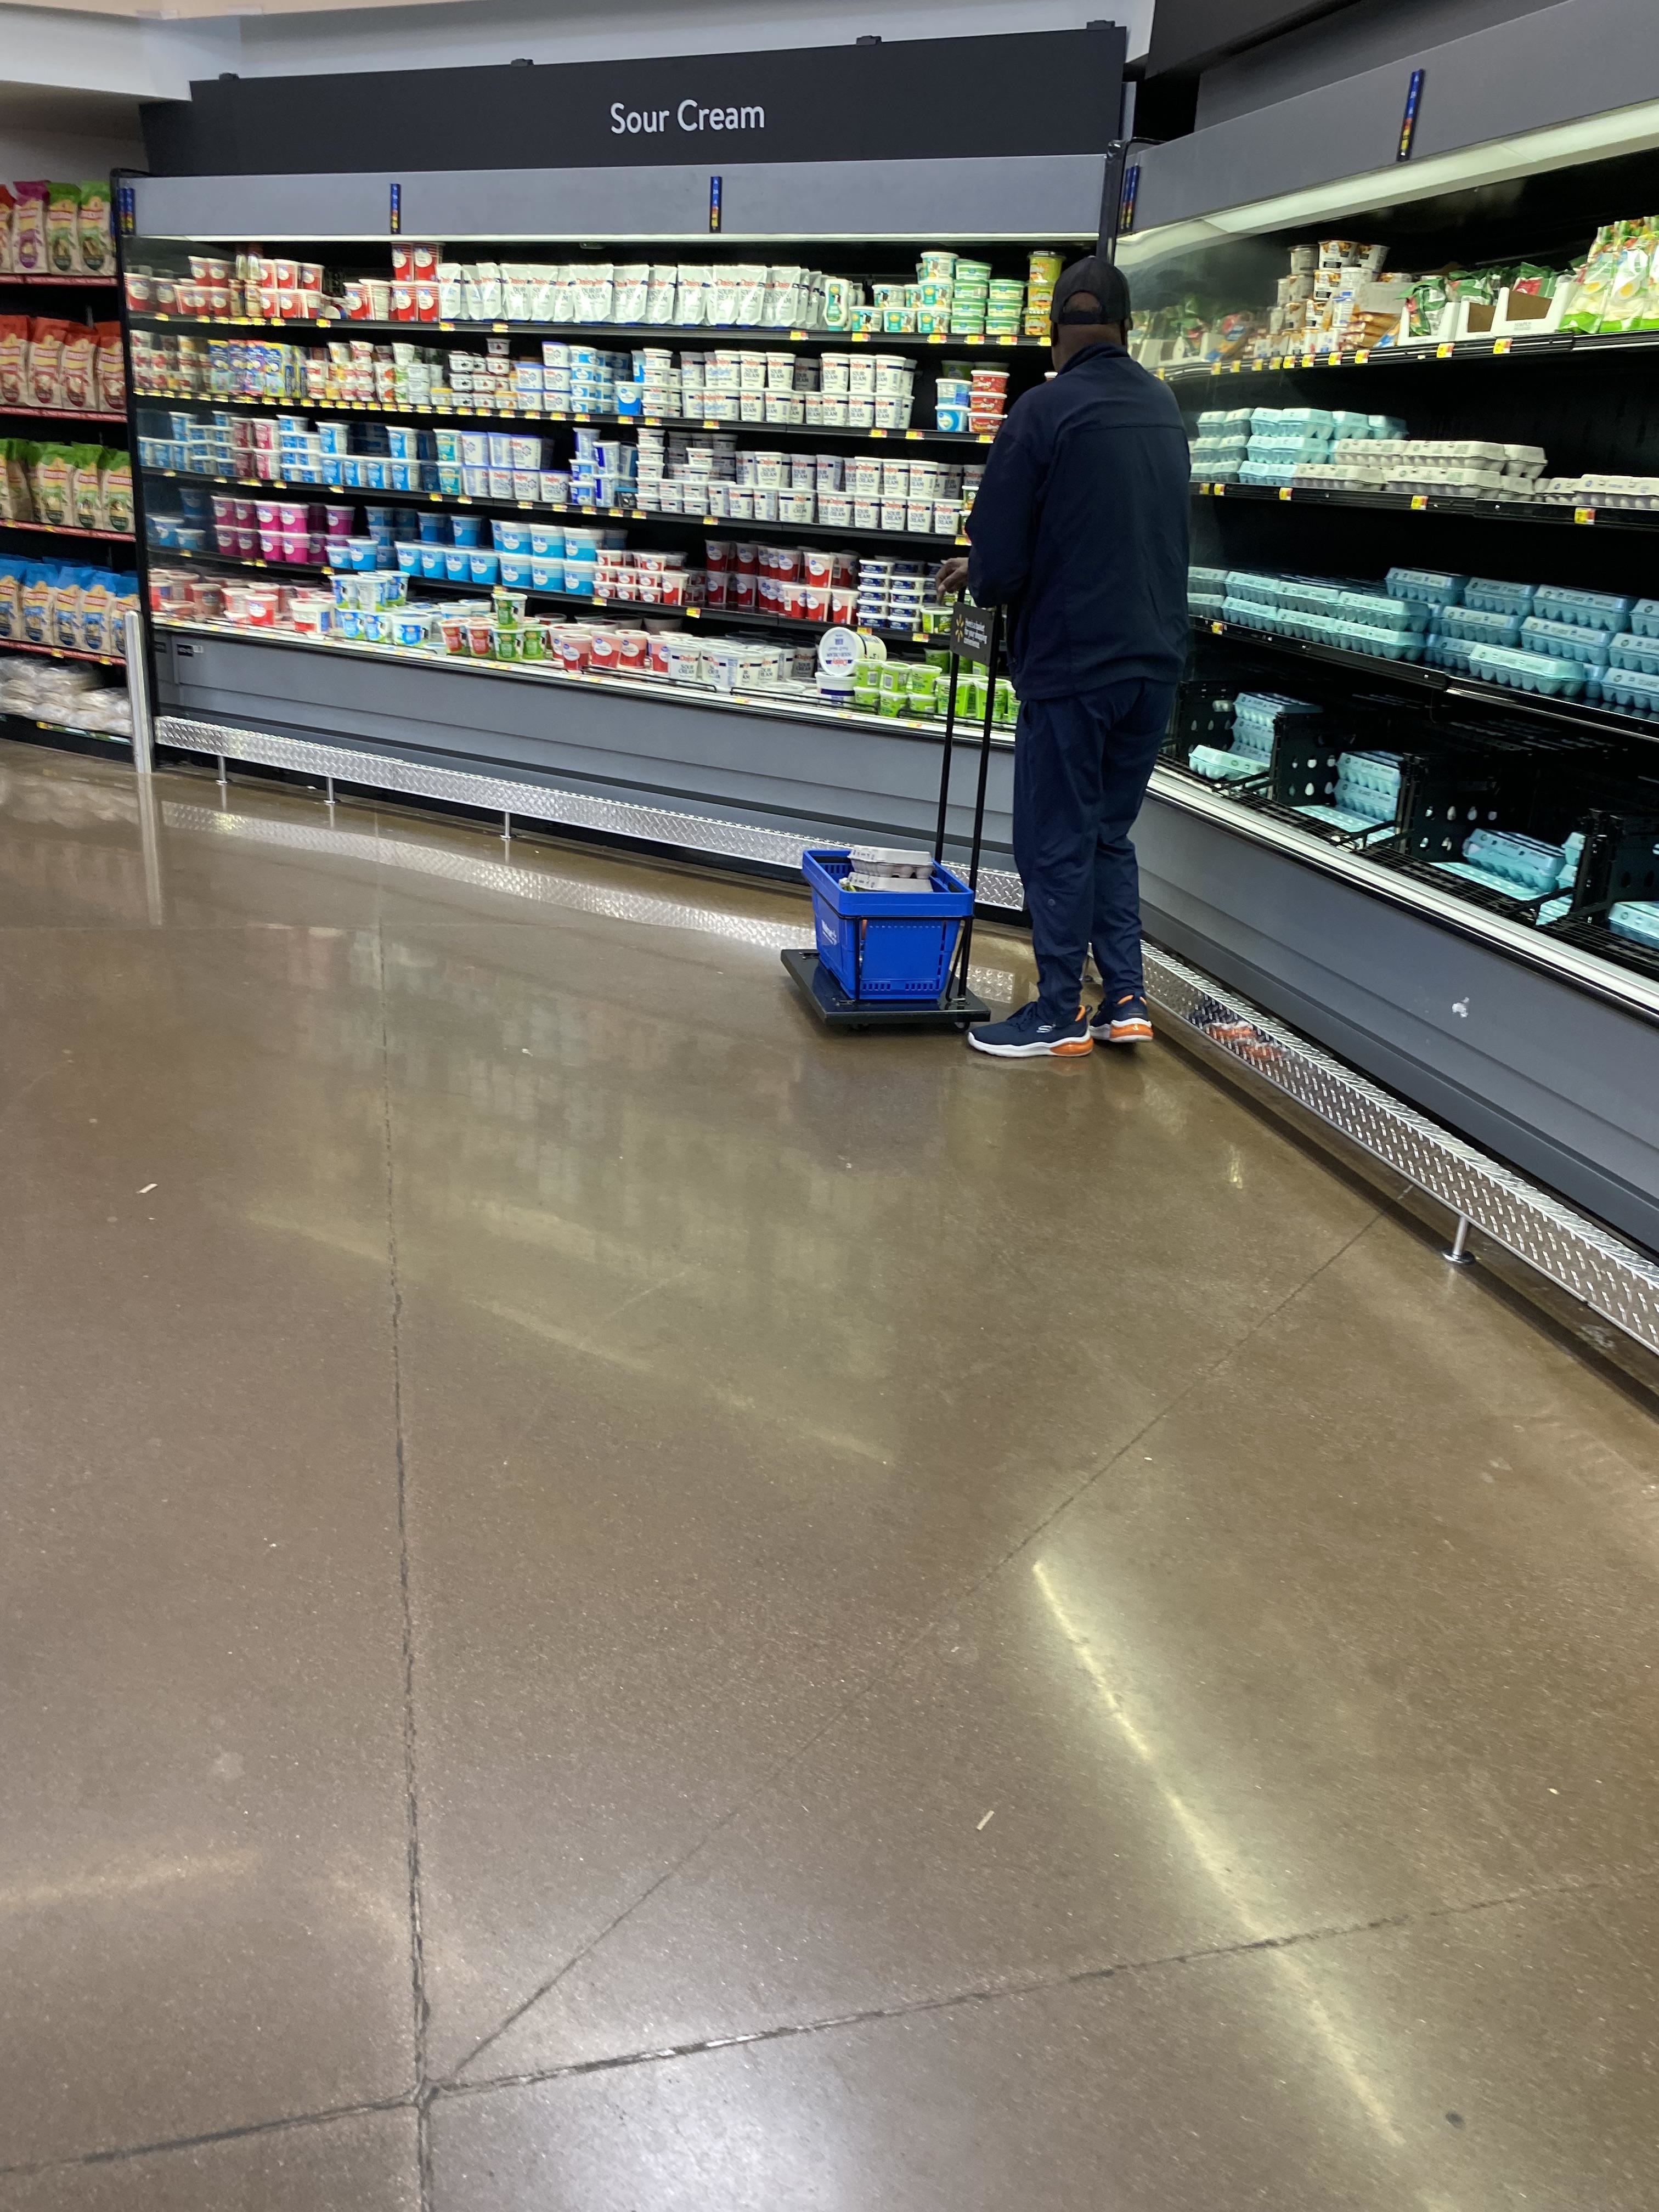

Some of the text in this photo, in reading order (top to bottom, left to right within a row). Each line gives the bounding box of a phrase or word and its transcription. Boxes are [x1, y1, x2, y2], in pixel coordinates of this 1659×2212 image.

[610, 99, 765, 134] Sour Cream
[909, 504, 925, 512] Daisy
[936, 505, 952, 514] Daisy
